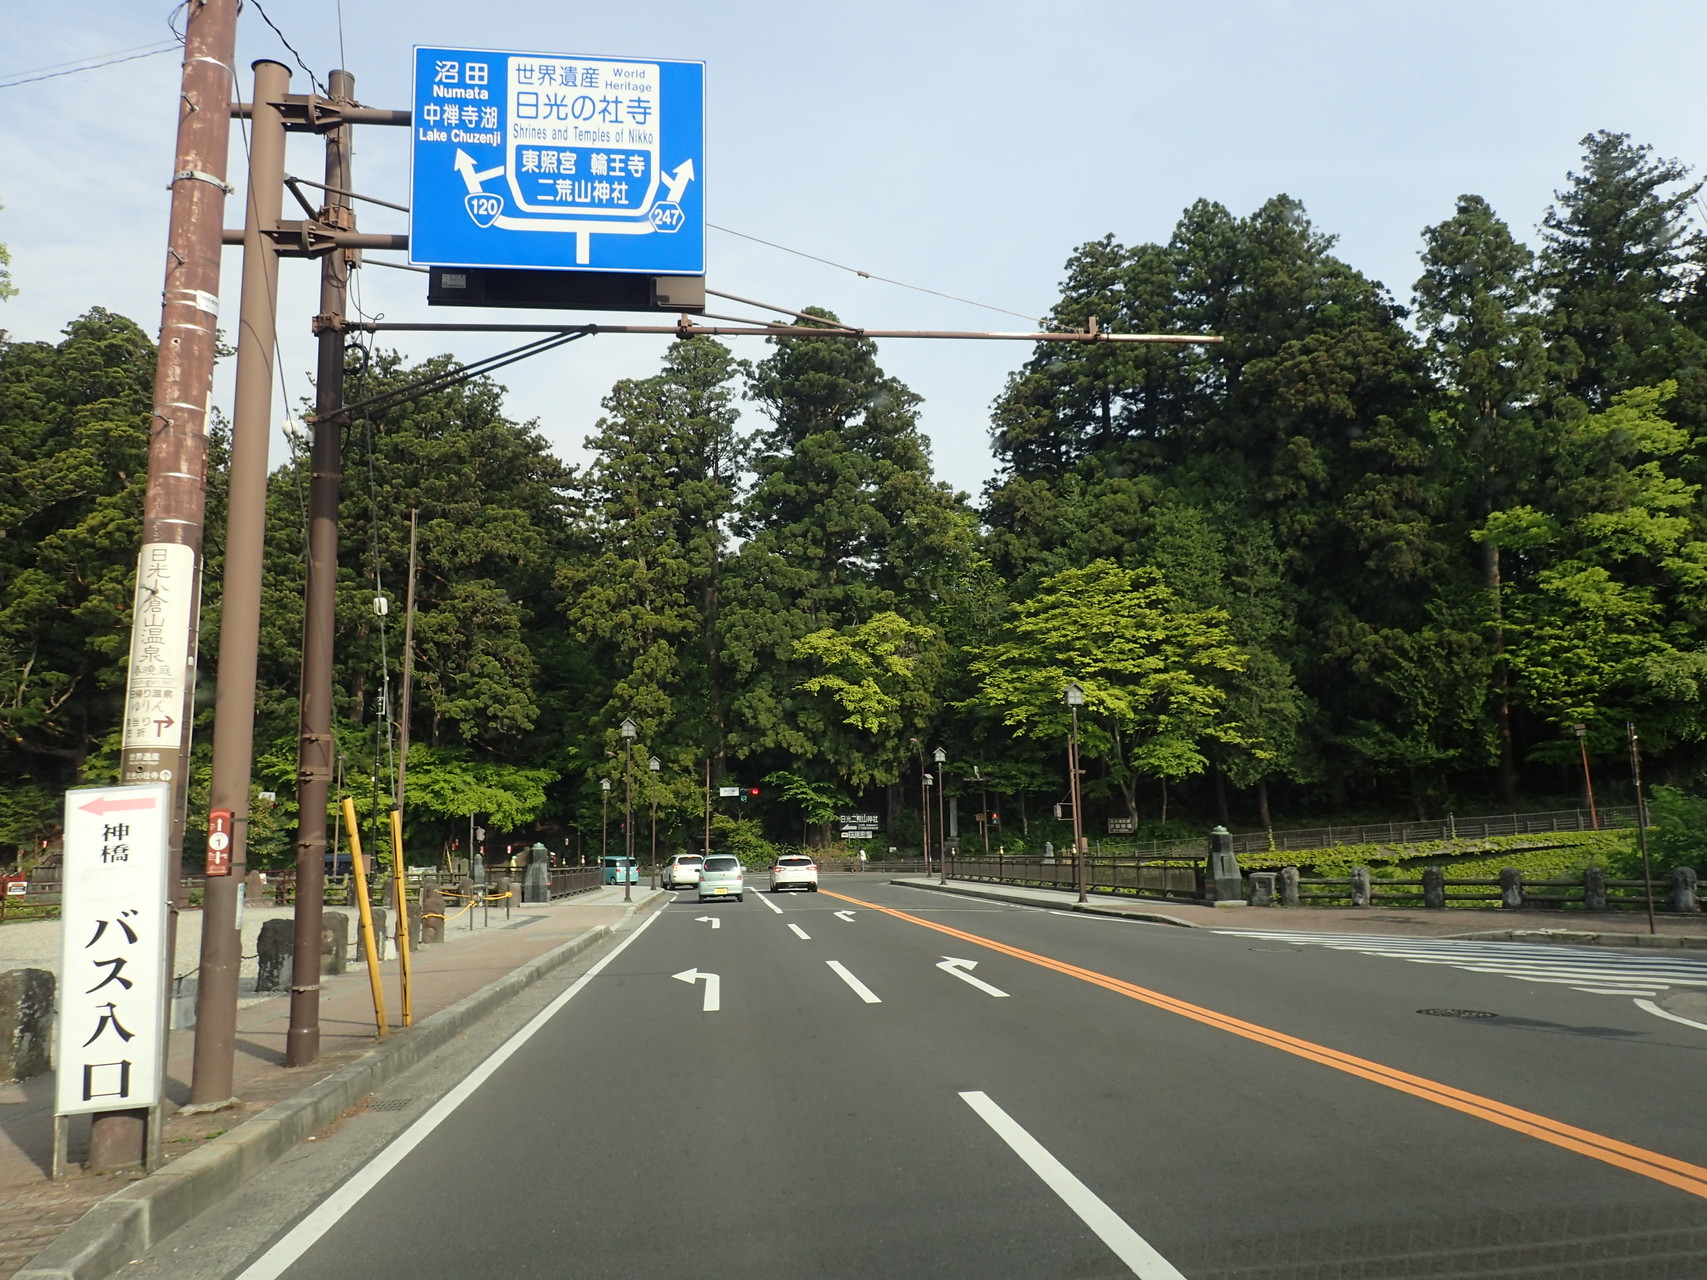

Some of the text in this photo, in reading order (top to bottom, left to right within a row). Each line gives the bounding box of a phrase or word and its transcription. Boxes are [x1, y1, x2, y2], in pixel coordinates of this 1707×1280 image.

[434, 60, 488, 85] 沼田
[516, 63, 600, 89] 世界遺産
[612, 67, 646, 79] World
[433, 85, 489, 100] Numata
[605, 80, 652, 93] Heritage
[424, 103, 498, 129] 中禅寺湖
[516, 91, 652, 125] 日光の社寺
[419, 128, 501, 147] Lake Chuzenji
[513, 123, 654, 144] Shrines and Temples of Nikko
[521, 150, 645, 177] 東照宮 輪王寺
[537, 179, 629, 204] 二荒山神社
[471, 199, 497, 215] 120
[654, 209, 680, 225] 247
[139, 548, 171, 663] 日光小倉山温泉
[102, 823, 130, 864] 神橋
[82, 909, 139, 1102] バス入口
